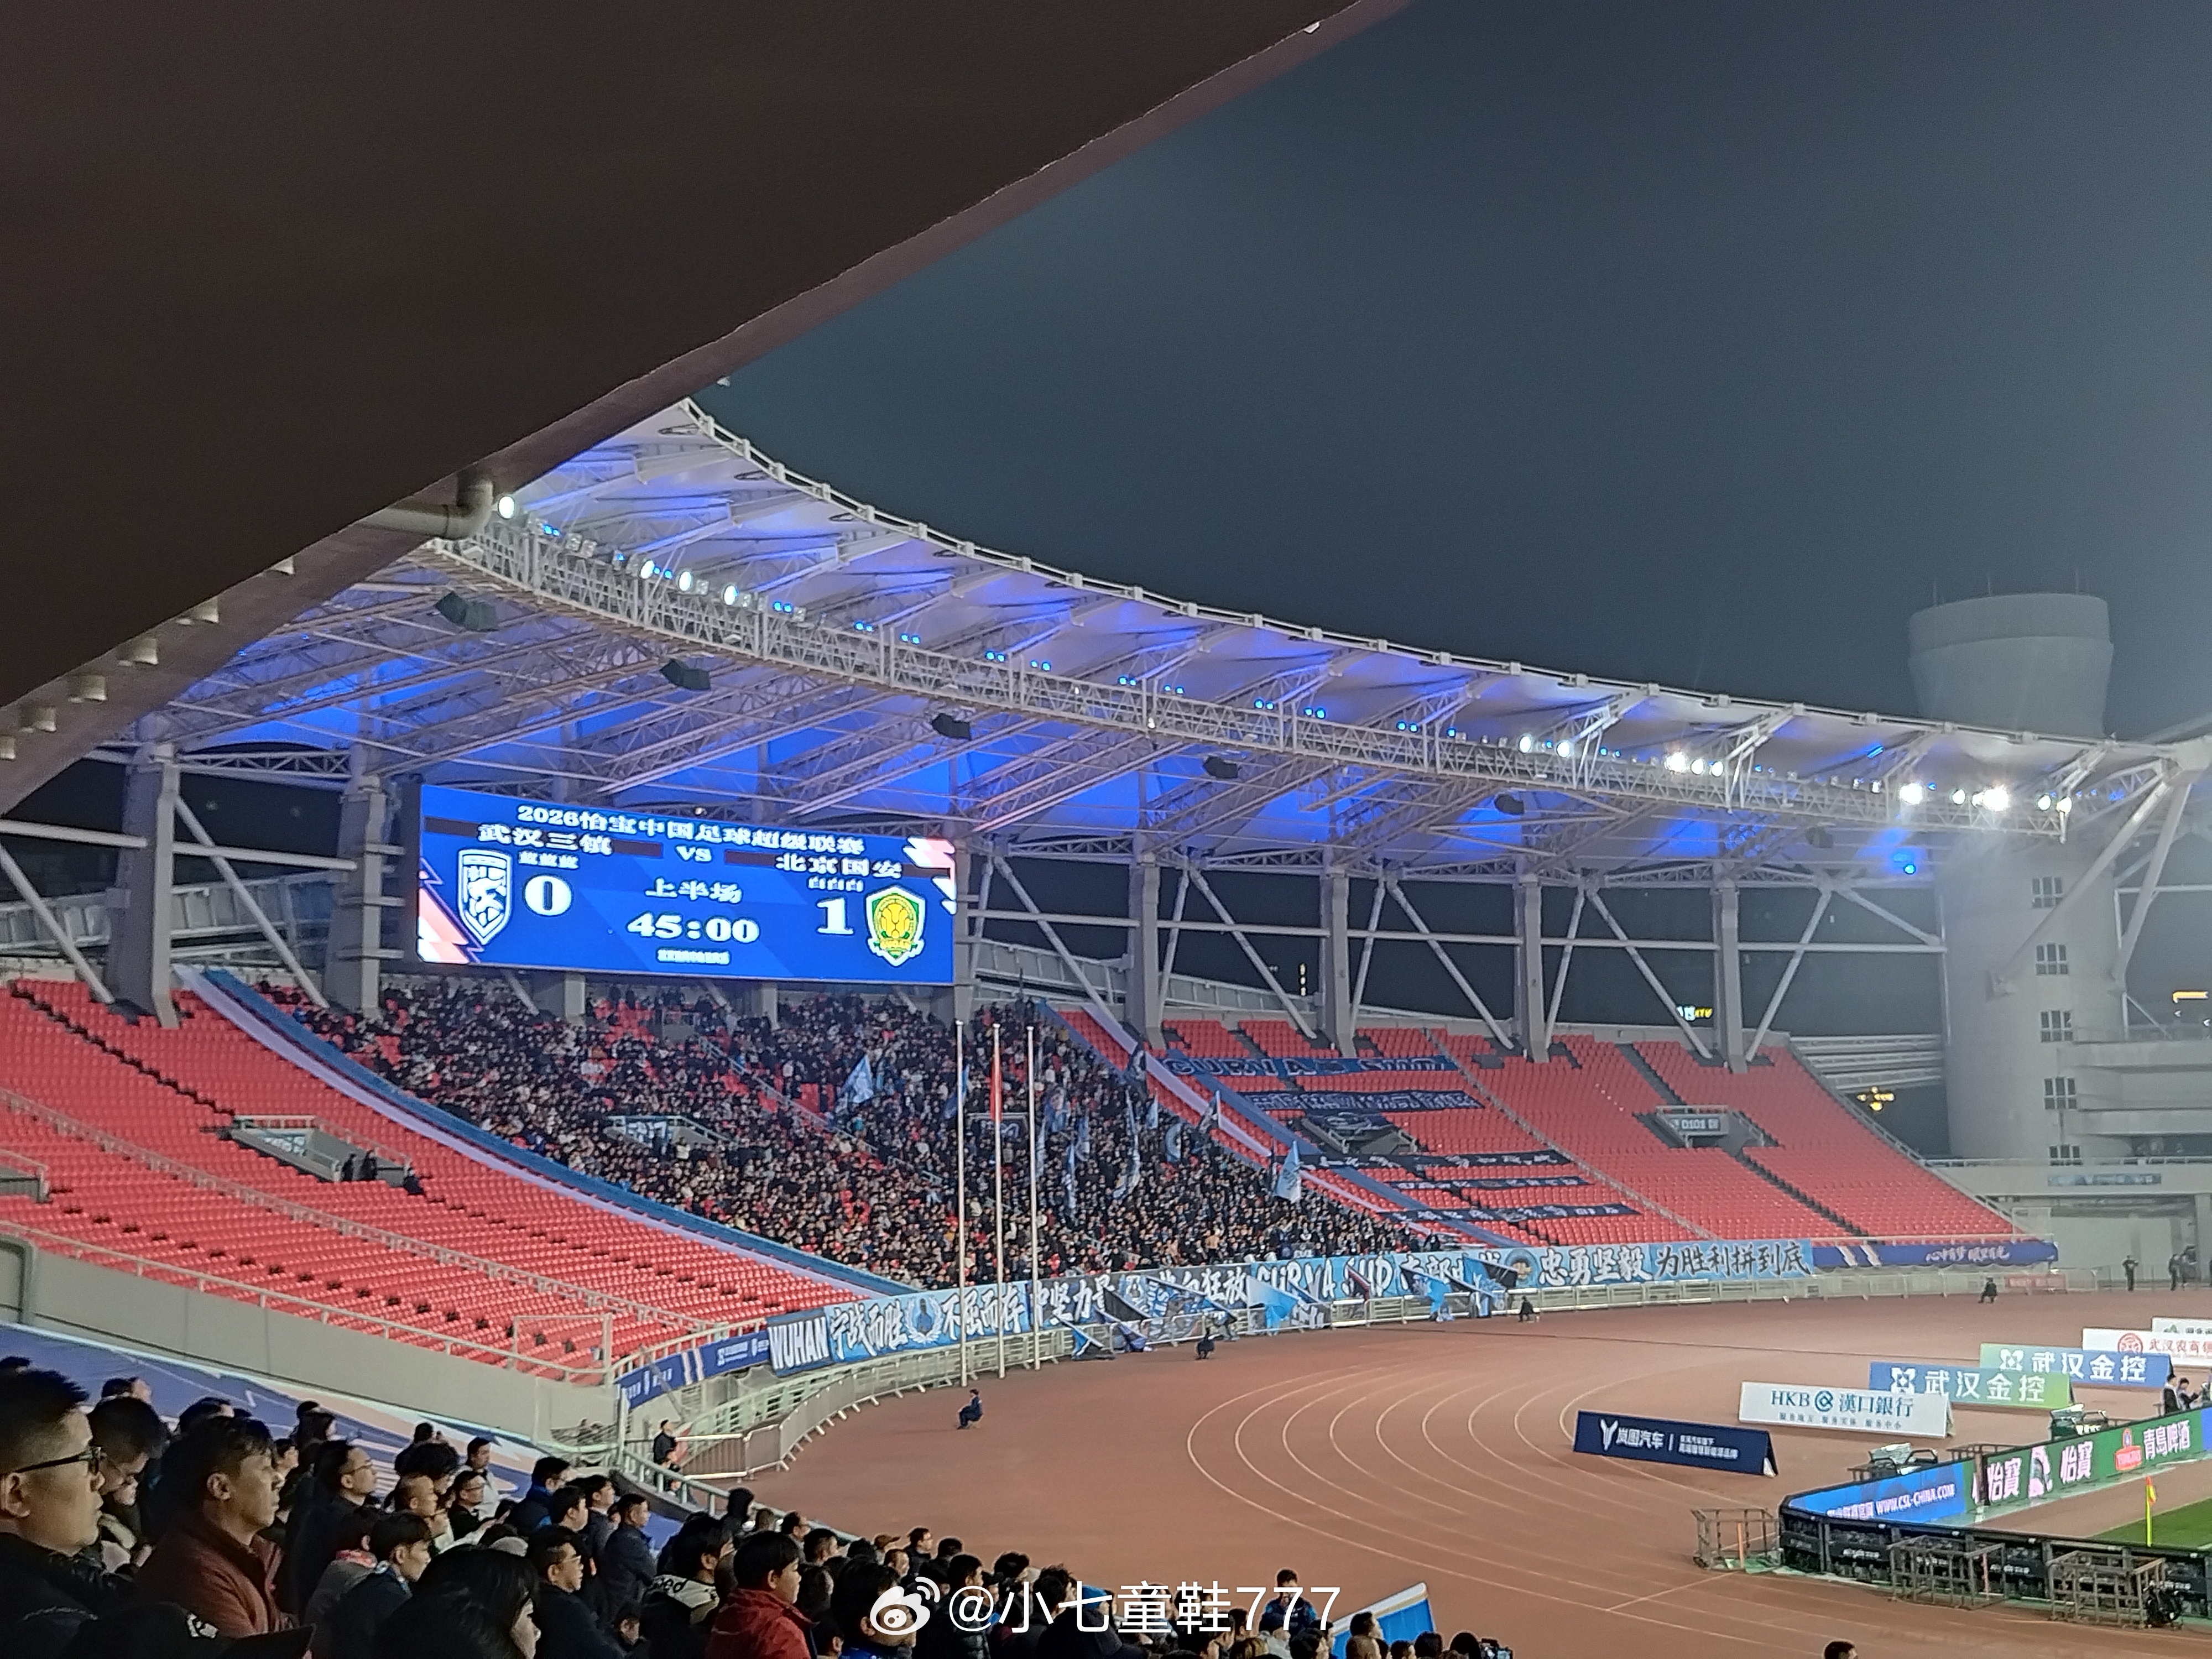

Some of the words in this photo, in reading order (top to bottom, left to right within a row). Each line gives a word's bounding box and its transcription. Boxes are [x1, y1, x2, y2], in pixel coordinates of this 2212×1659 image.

[477, 823, 612, 855] 武汉三镇
[675, 845, 713, 863] VS
[775, 853, 902, 879] 北京国安
[524, 875, 572, 916] 0
[644, 877, 743, 904] 上半场
[627, 912, 760, 943] 45:00
[816, 898, 854, 935] 1
[1538, 1245, 1653, 1286] 忠勇坚毅
[1657, 1240, 1812, 1278] 为胜利拼到底
[1256, 1258, 1335, 1300] CURVA
[768, 1316, 830, 1370] WUHAN
[831, 1298, 909, 1360] 宁战而胜
[2031, 1352, 2147, 1382] 武汉金控
[1924, 1369, 2045, 1402] 武汉金控
[1771, 1390, 1810, 1407] HKB
[1839, 1392, 1914, 1417] 漢口銀行
